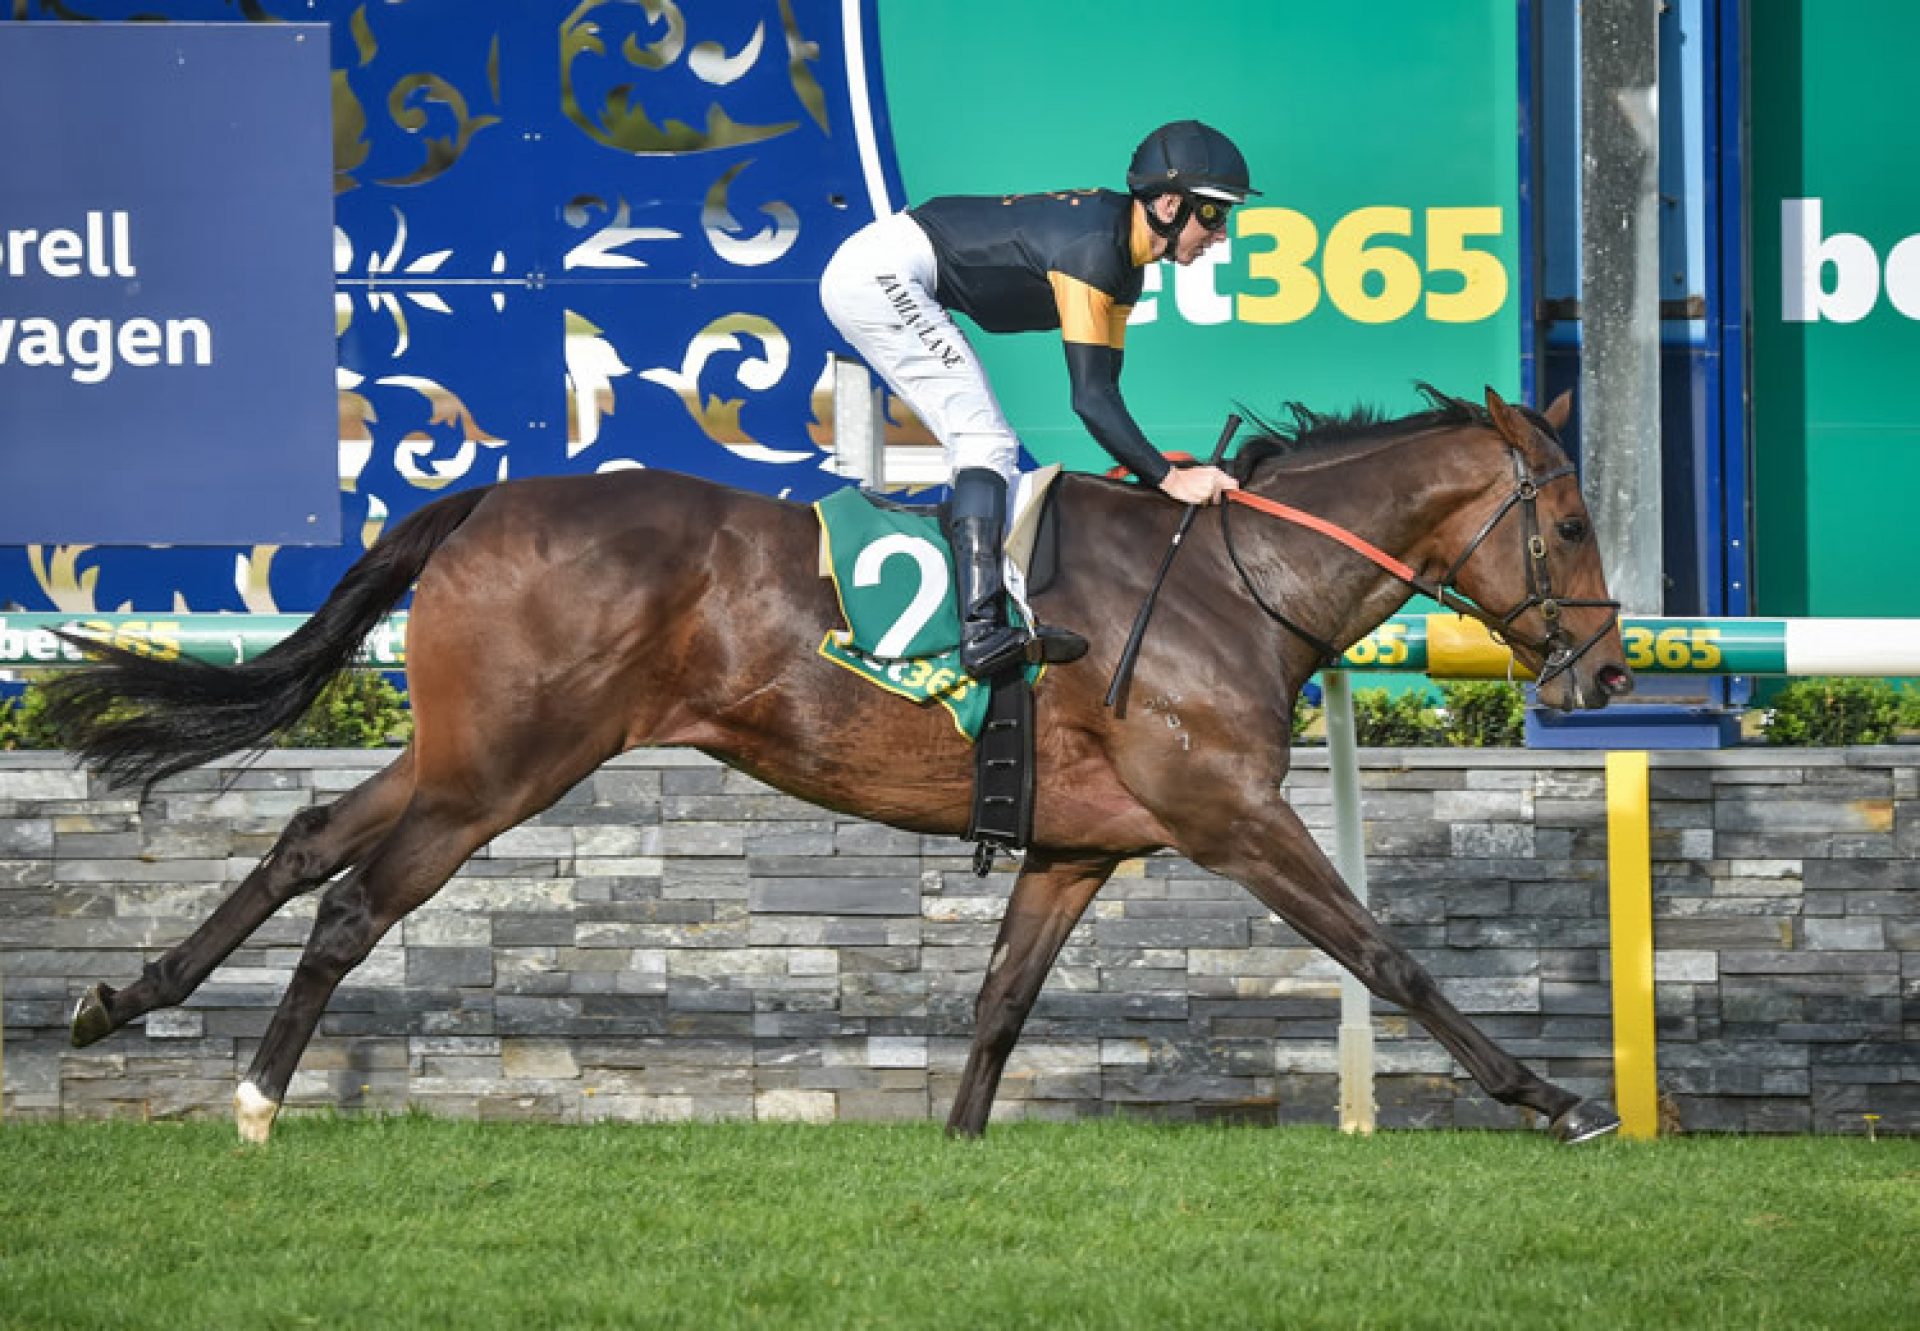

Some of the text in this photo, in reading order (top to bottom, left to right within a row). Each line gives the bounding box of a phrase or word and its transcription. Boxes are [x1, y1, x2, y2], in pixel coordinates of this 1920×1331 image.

[0, 210, 136, 277] rell
[854, 532, 949, 659] 2
[1625, 627, 1721, 669] 365
